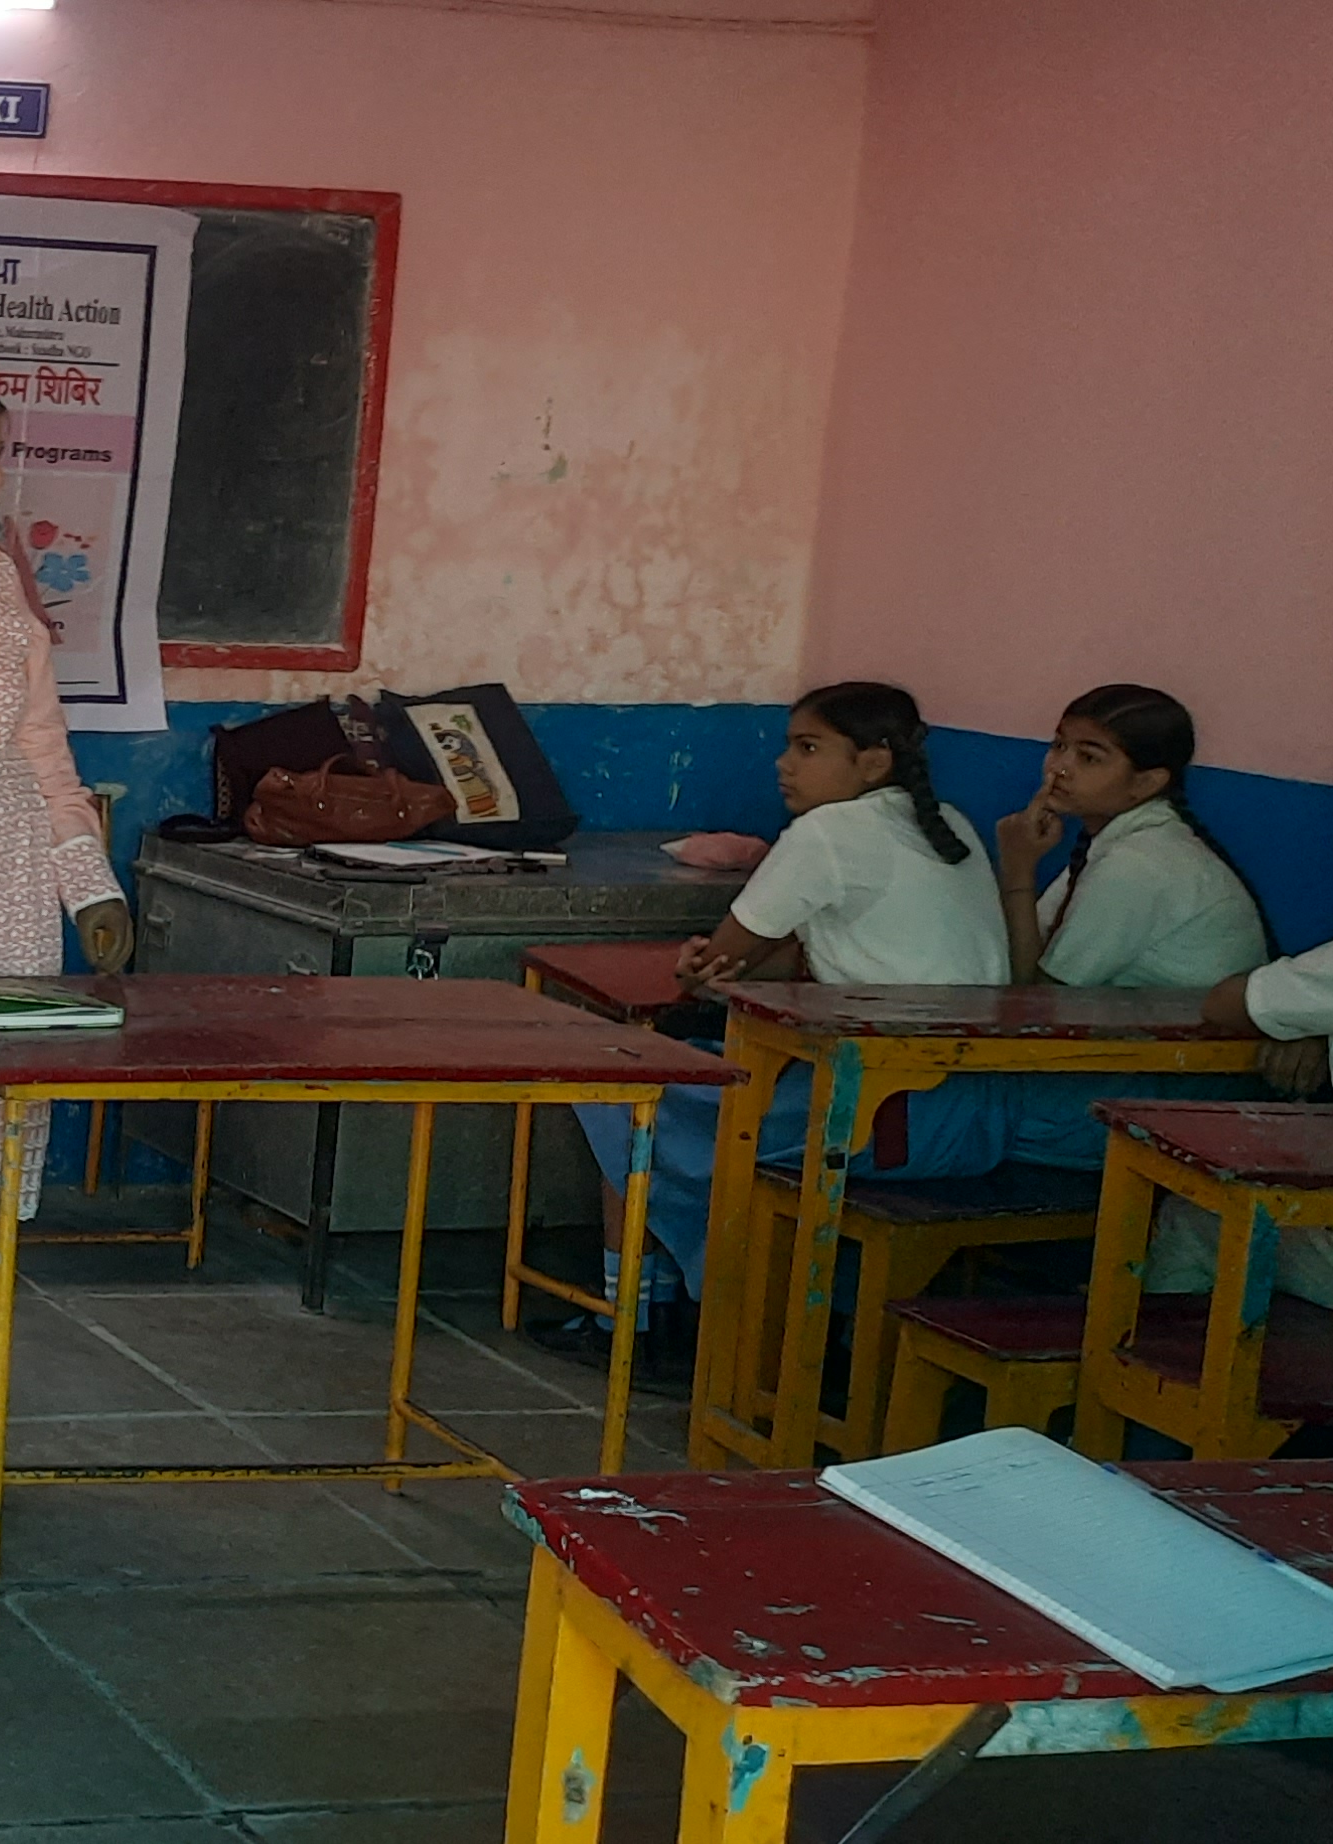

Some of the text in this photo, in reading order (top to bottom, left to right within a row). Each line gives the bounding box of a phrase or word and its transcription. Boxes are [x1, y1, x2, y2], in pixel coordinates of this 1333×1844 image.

[58, 299, 121, 325] Action
[35, 366, 103, 406] शिबिर
[11, 442, 112, 463] Programs
